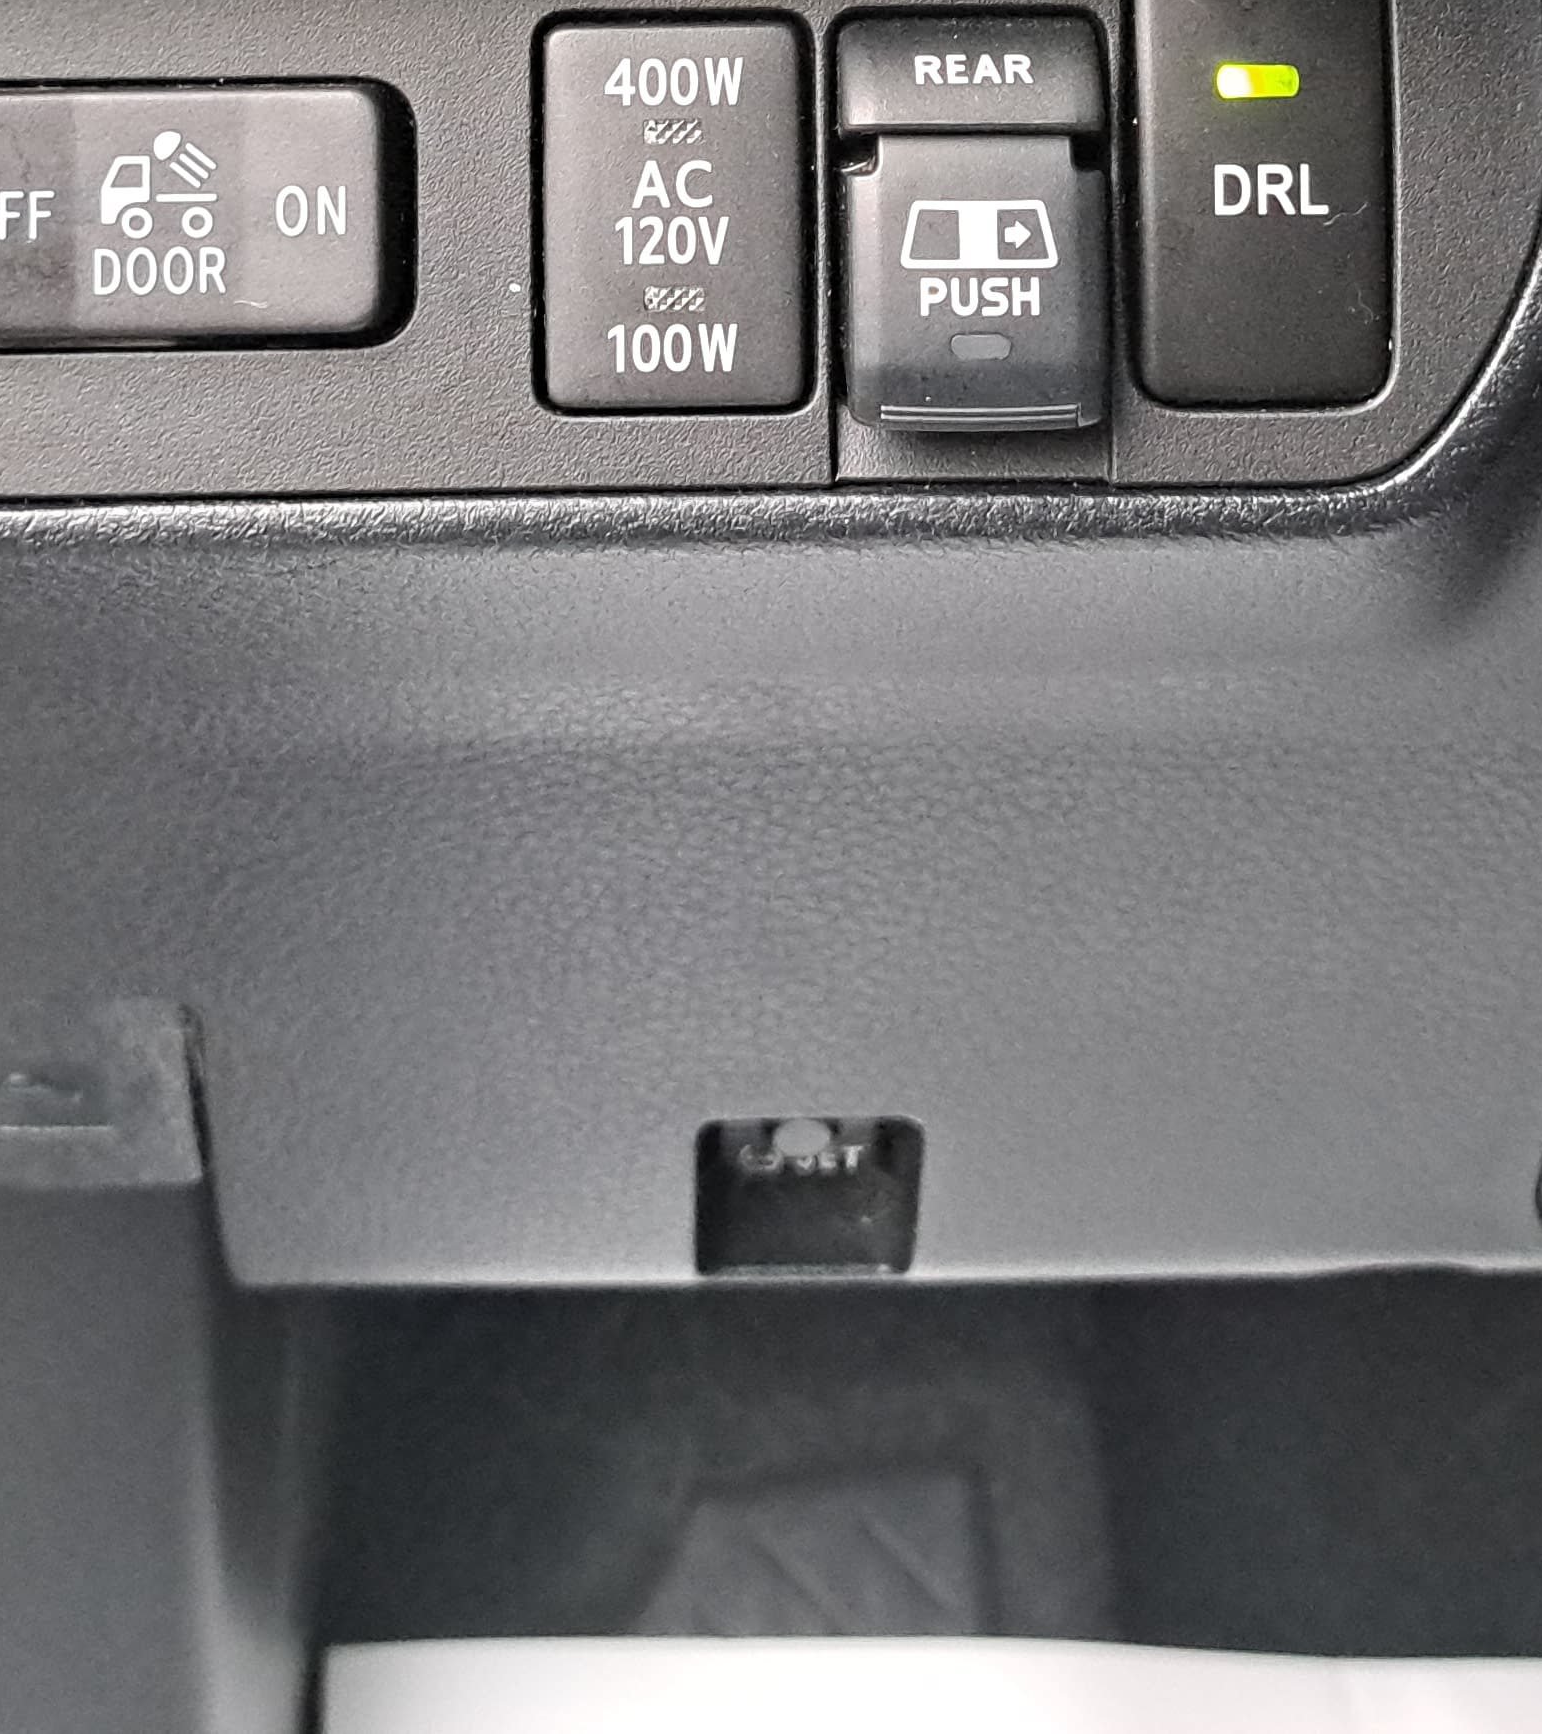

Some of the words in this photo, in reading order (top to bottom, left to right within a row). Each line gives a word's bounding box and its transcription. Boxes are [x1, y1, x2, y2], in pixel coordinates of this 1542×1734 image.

[603, 55, 745, 108] 400W
[913, 53, 1035, 86] REAR
[630, 158, 714, 210] AC
[1213, 162, 1330, 217] DRL
[274, 183, 347, 238] ON
[613, 214, 731, 266] 120V
[92, 244, 227, 297] DOOR
[918, 275, 1041, 318] PUSH
[606, 322, 739, 374] 100W
